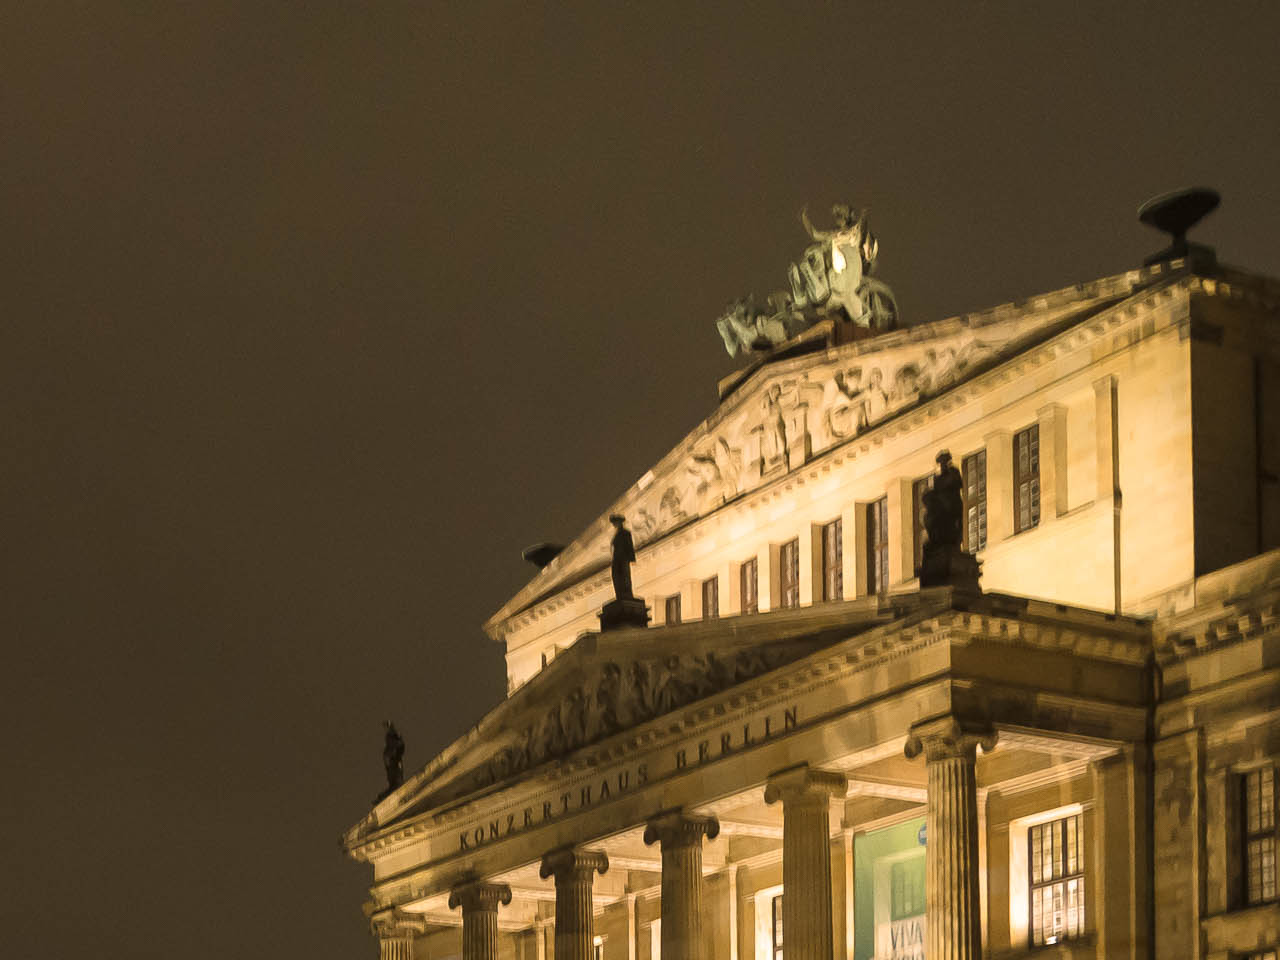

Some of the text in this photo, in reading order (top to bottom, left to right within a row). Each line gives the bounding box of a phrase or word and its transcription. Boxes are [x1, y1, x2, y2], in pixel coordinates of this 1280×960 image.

[459, 705, 798, 850] KONZERTHAUS BERLIN
[890, 919, 924, 951] VIVA
